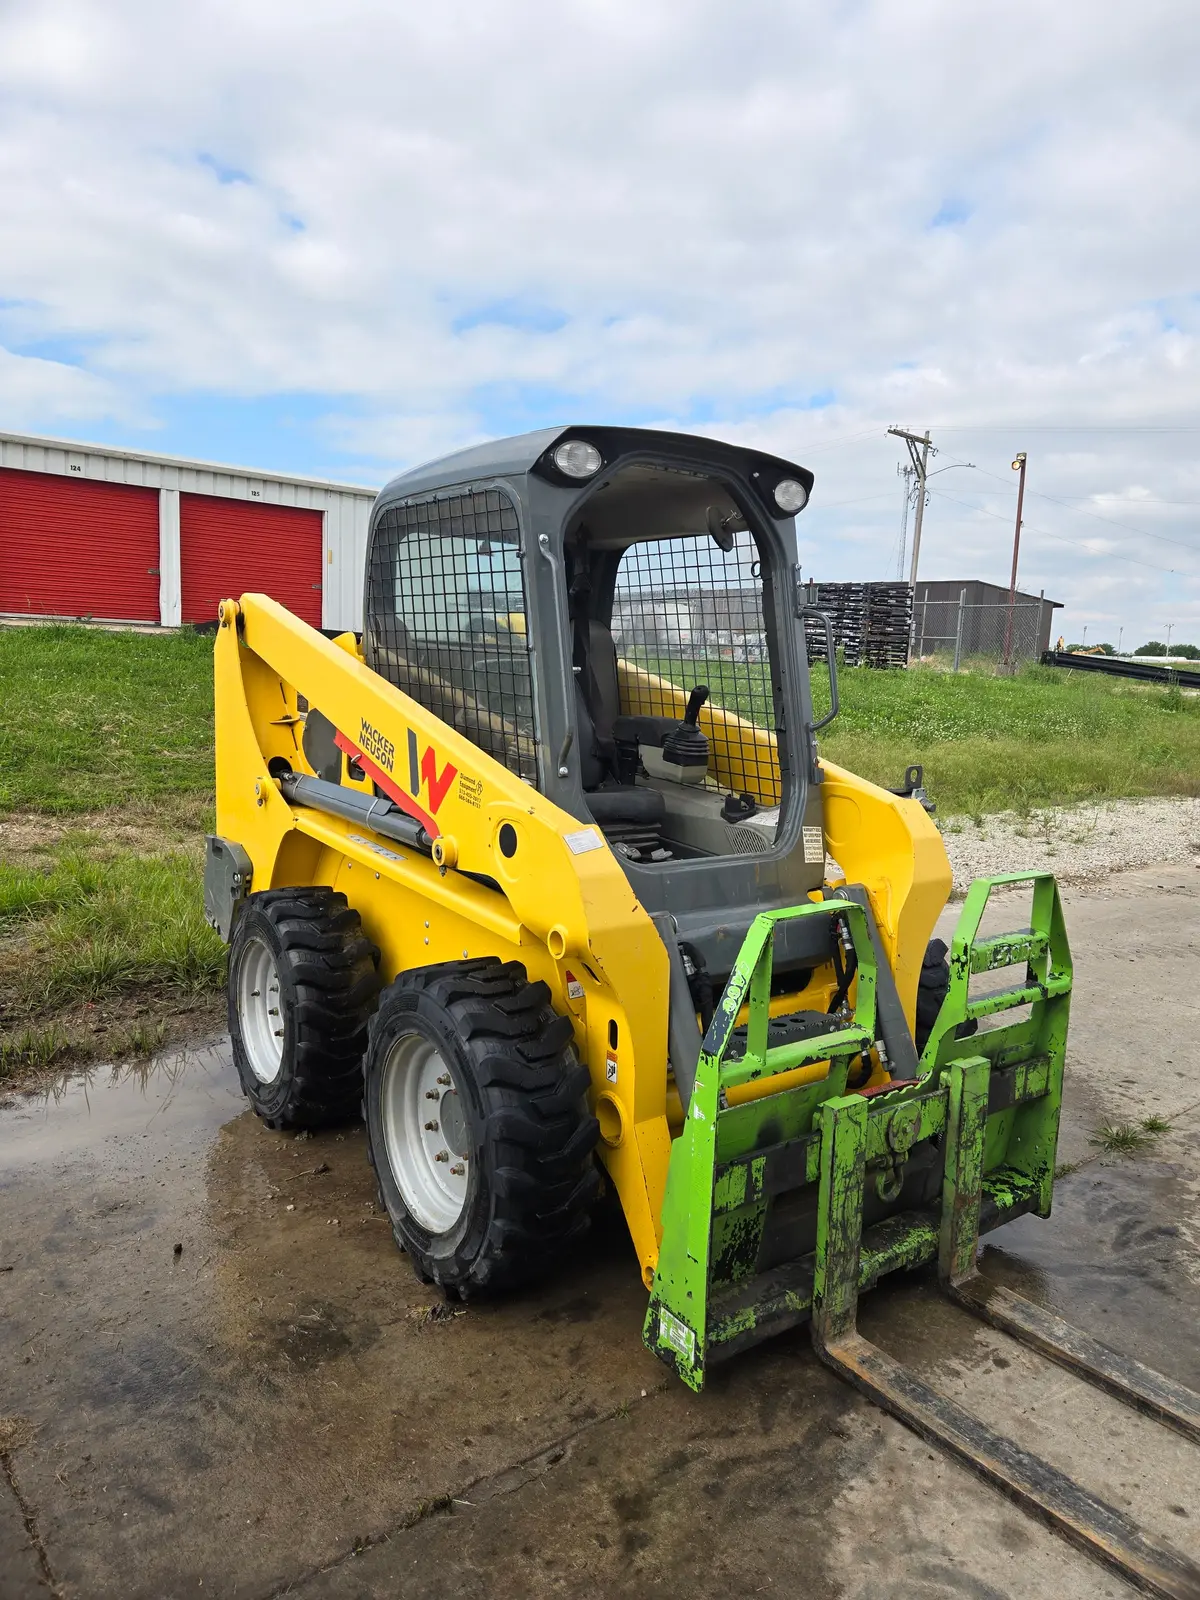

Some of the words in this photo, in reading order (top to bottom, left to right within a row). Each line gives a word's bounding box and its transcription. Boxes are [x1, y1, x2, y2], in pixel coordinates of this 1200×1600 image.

[70, 464, 81, 472] 124
[361, 717, 395, 759] WACKER
[359, 731, 394, 773] NEUSON
[460, 772, 476, 785] Diamond
[459, 780, 477, 795] Equipment
